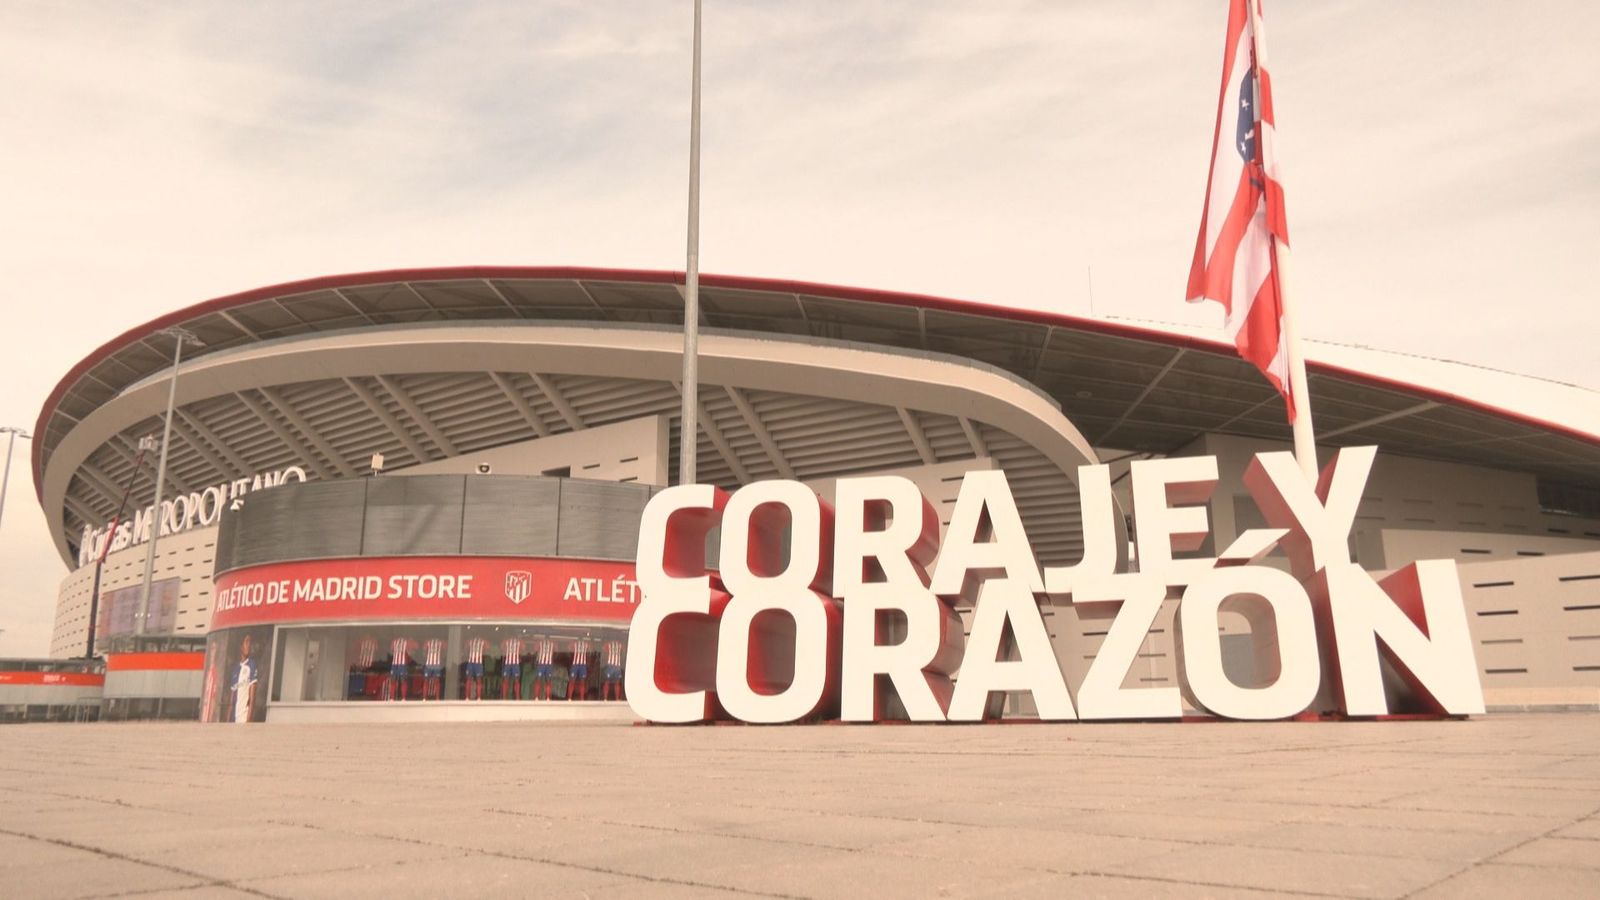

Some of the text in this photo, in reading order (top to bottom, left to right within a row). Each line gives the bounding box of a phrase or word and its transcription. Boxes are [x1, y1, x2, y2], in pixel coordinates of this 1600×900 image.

[133, 465, 307, 545] MEROPOLT
[635, 445, 1379, 598] CORAJE Y
[216, 574, 473, 613] ATLÉTICO DE MADRID STORE
[624, 528, 1487, 724] CORAZÓN
